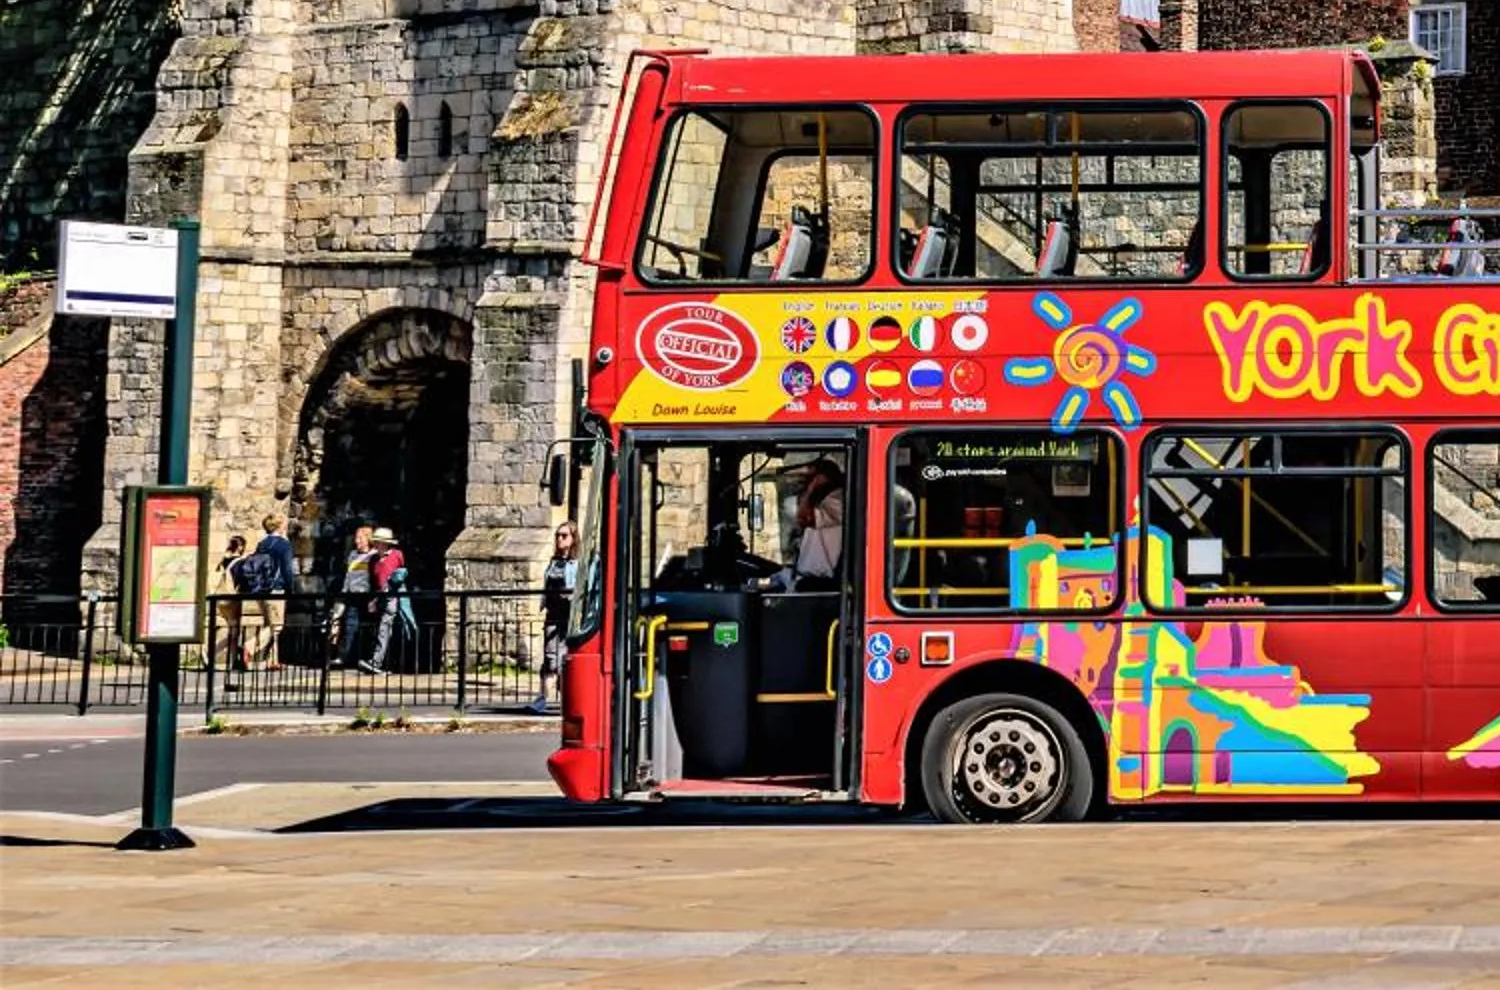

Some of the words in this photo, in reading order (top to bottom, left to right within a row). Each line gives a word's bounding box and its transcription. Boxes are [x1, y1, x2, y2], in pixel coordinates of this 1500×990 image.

[684, 308, 724, 323] TOUR
[659, 335, 736, 360] OFFICIAL
[661, 365, 679, 381] OF
[684, 373, 721, 387] YORK
[652, 403, 689, 416] Dawn
[694, 403, 737, 416] Louise
[999, 440, 1045, 457] around
[1049, 441, 1080, 457] York
